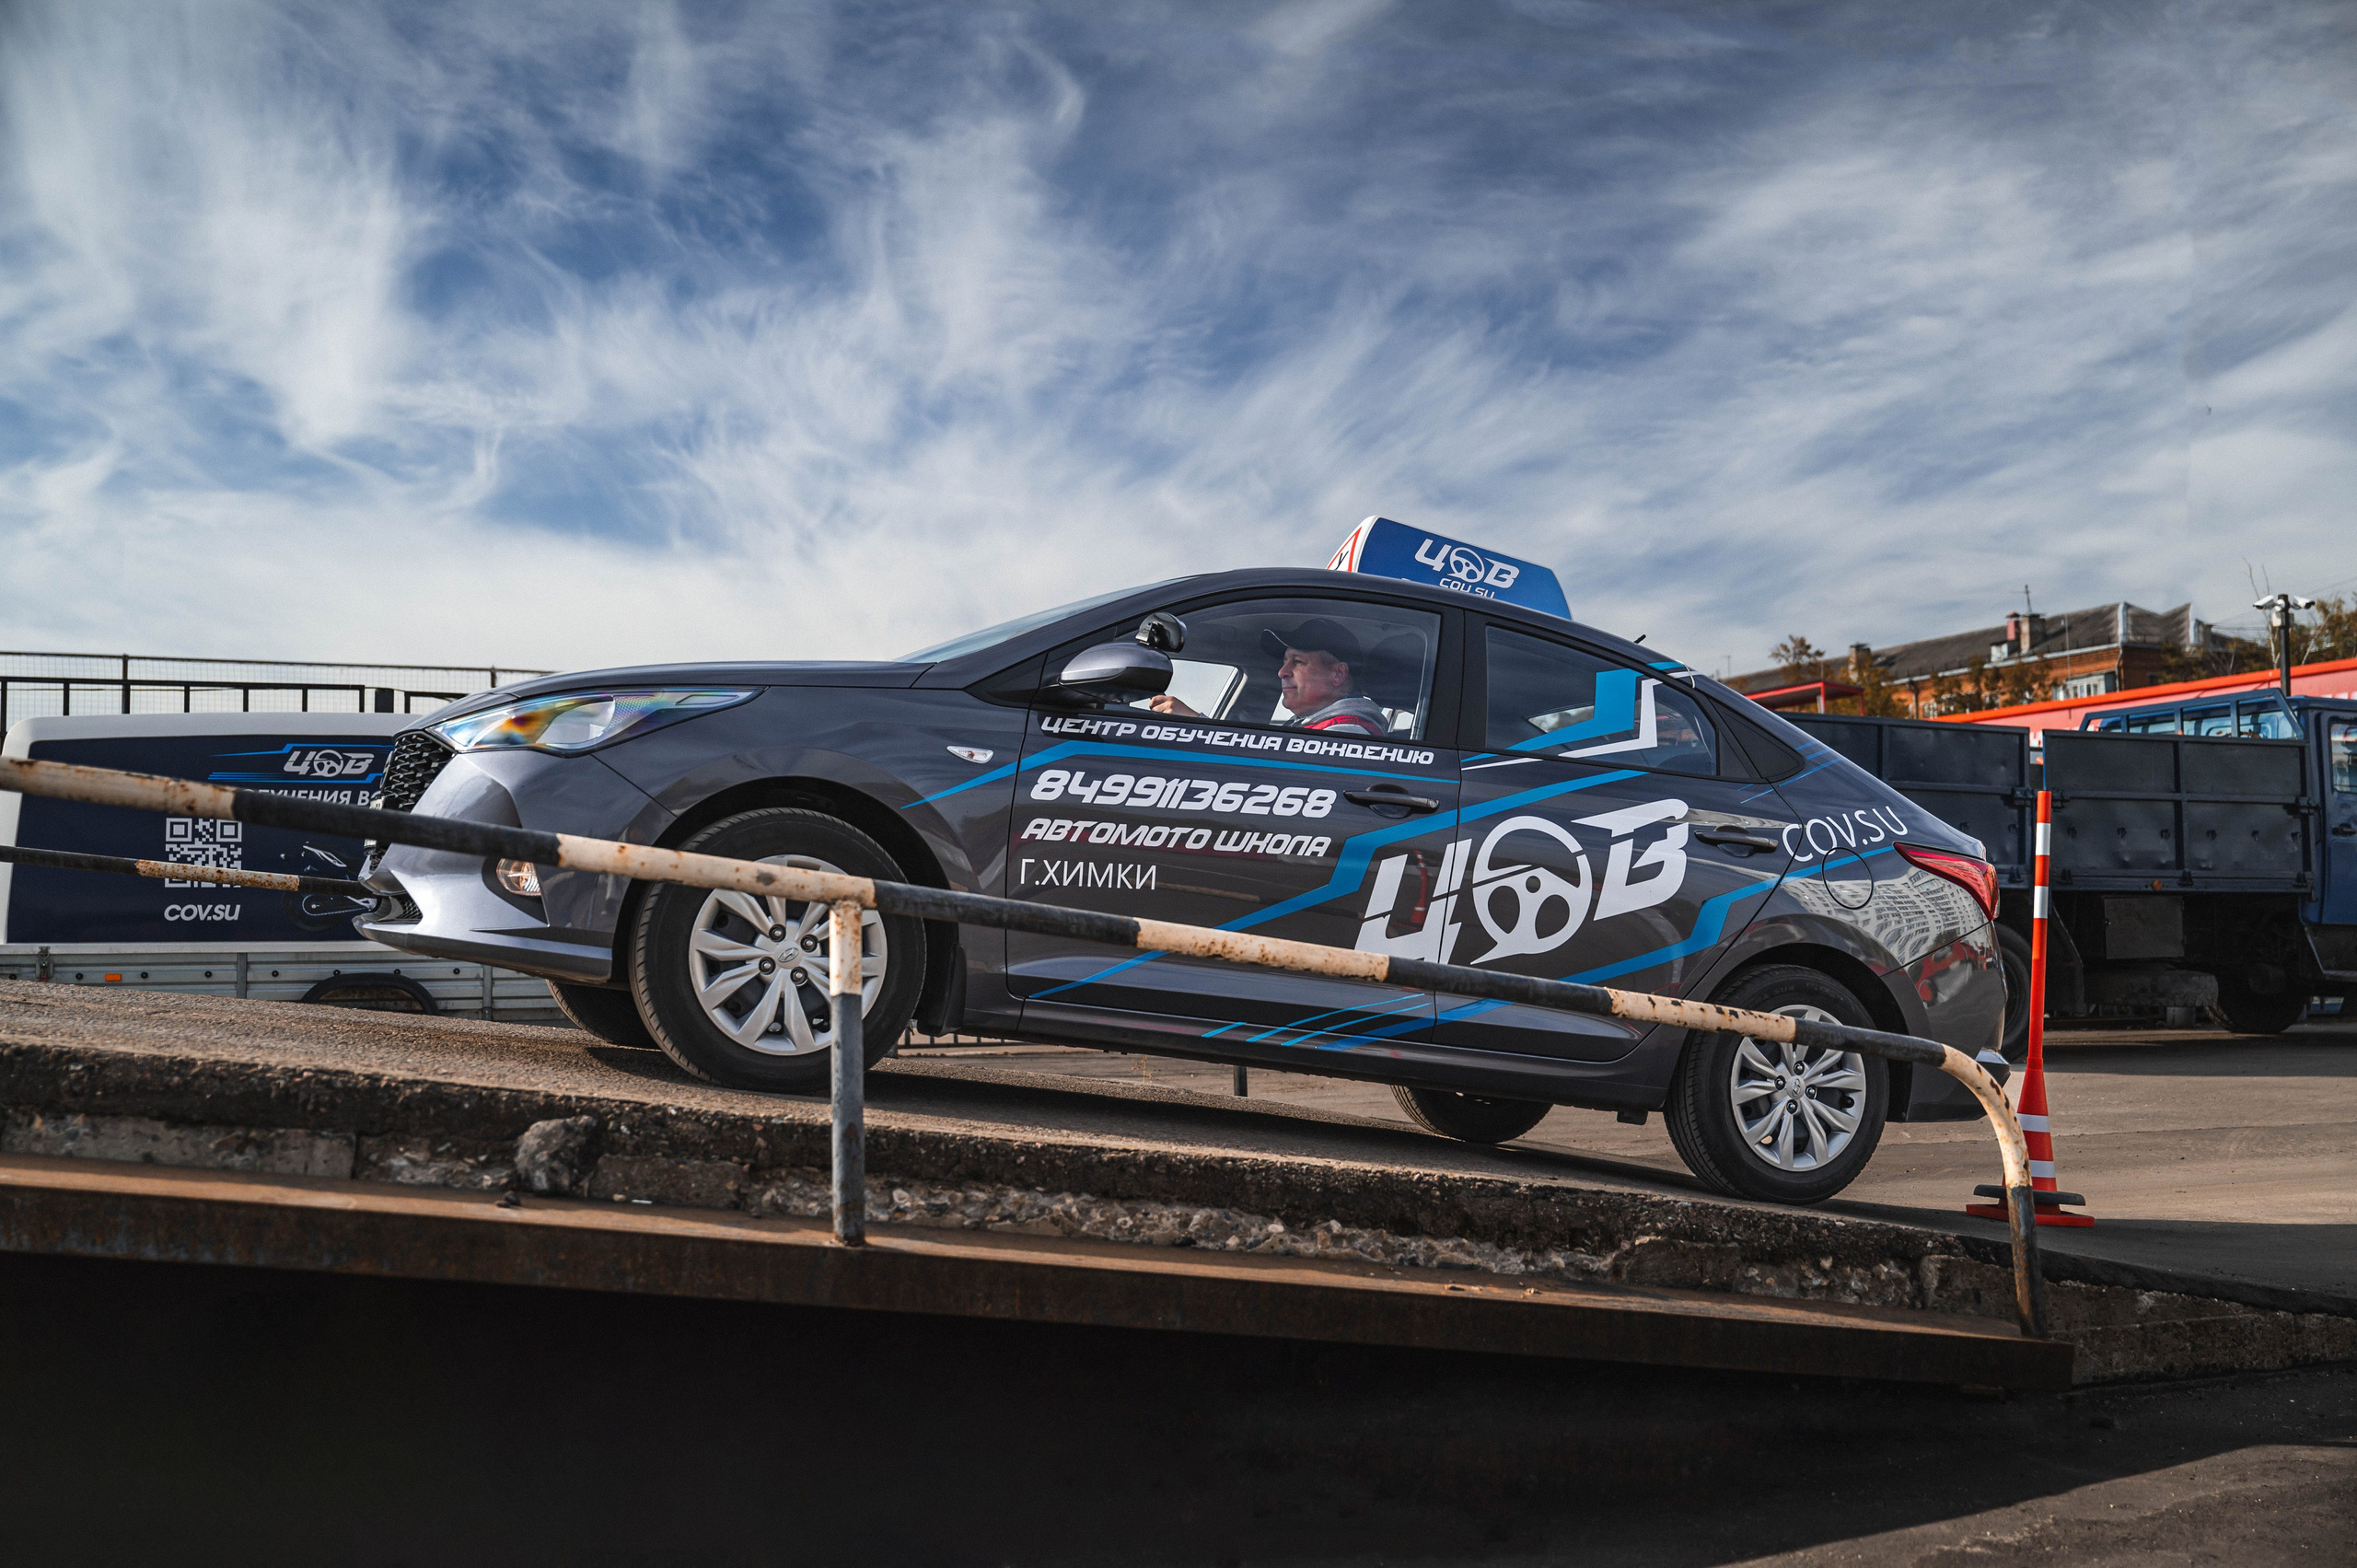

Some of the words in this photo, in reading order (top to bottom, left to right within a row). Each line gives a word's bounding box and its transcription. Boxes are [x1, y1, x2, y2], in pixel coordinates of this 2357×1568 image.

[1040, 716, 1137, 737] ЦЕНТР
[1141, 725, 1283, 751] ОБУЧЕНИЯ
[1286, 738, 1434, 765] ВОЖДЕНИЮ
[1030, 769, 1338, 819] 84991136268
[1020, 818, 1213, 850] АВТОМОТО
[1213, 830, 1332, 857] ШКОЛА
[1782, 806, 1909, 863] COV.SU
[1020, 858, 1156, 890] Г.ХИМКИ
[164, 903, 241, 922] COV.SU
